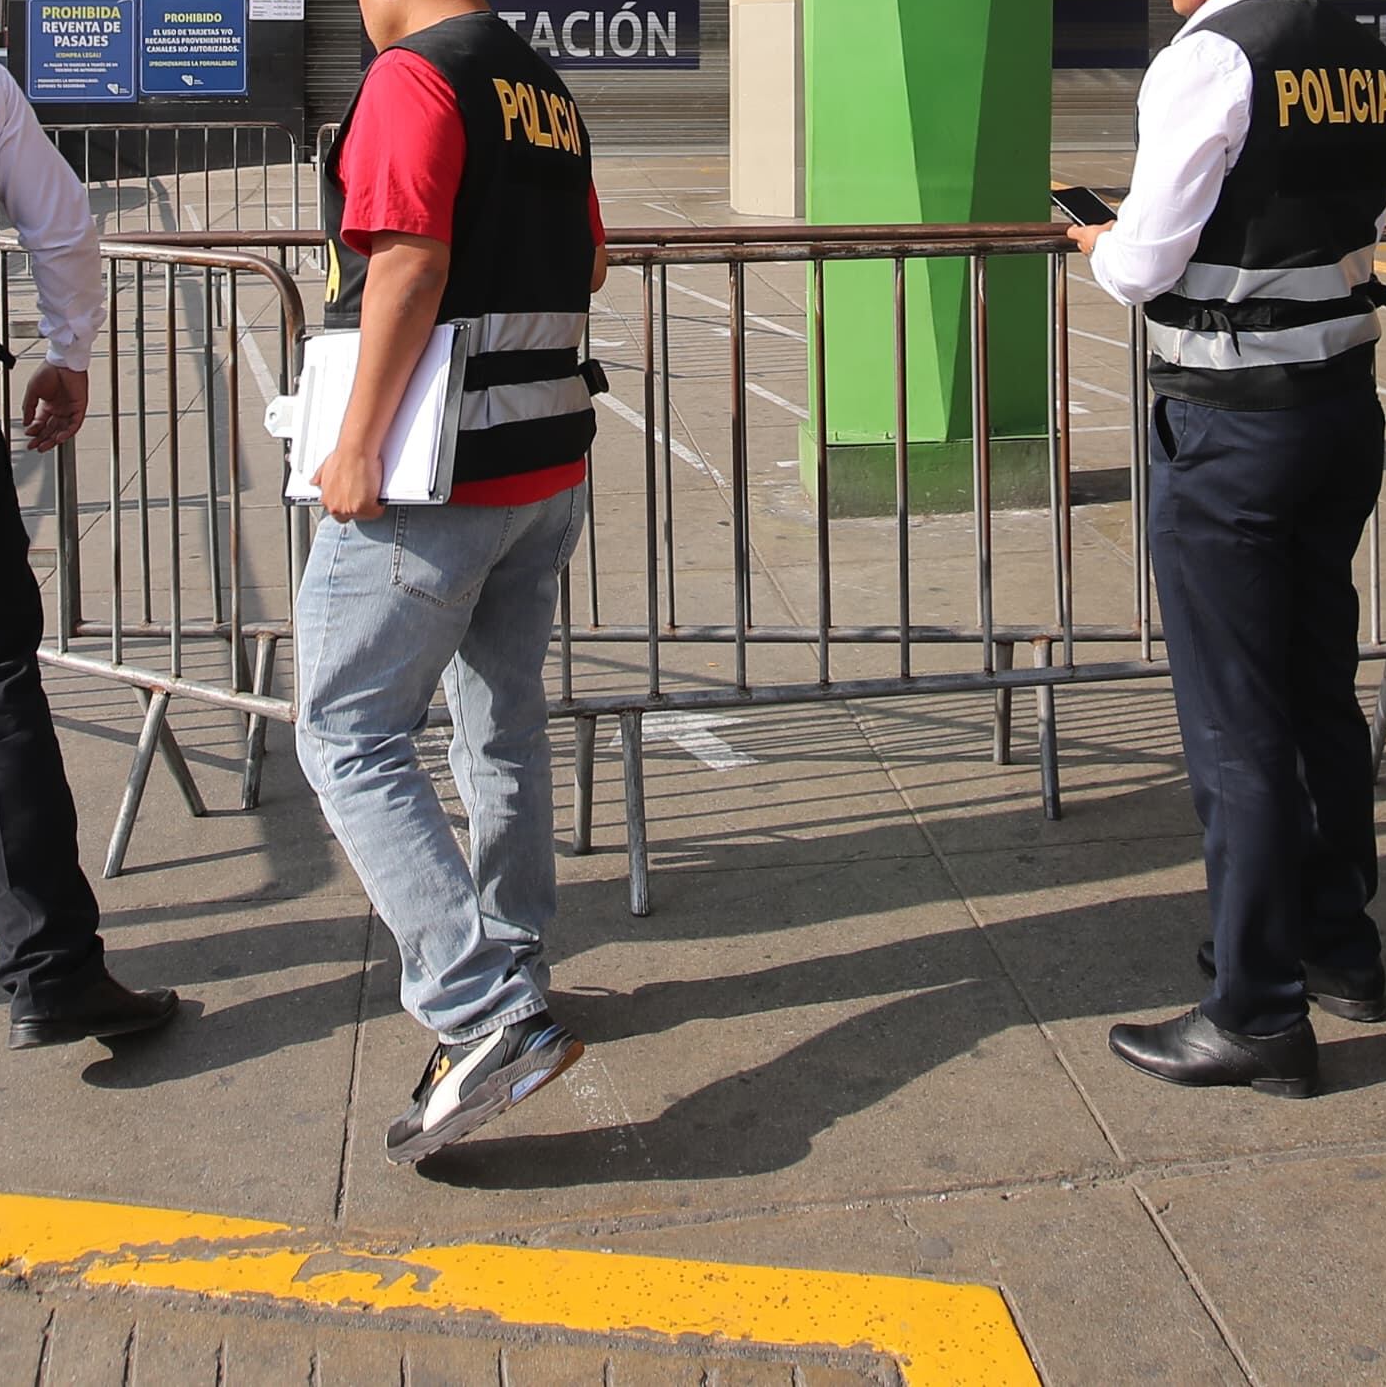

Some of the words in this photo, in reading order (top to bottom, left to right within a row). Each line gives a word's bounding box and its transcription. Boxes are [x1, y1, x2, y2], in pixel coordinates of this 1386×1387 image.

[42, 6, 121, 19] PROHIBIDA
[164, 13, 222, 23] PROHIBIDO
[42, 21, 100, 33] REVENTA
[104, 21, 121, 33] DE
[54, 35, 109, 47] PASAJES
